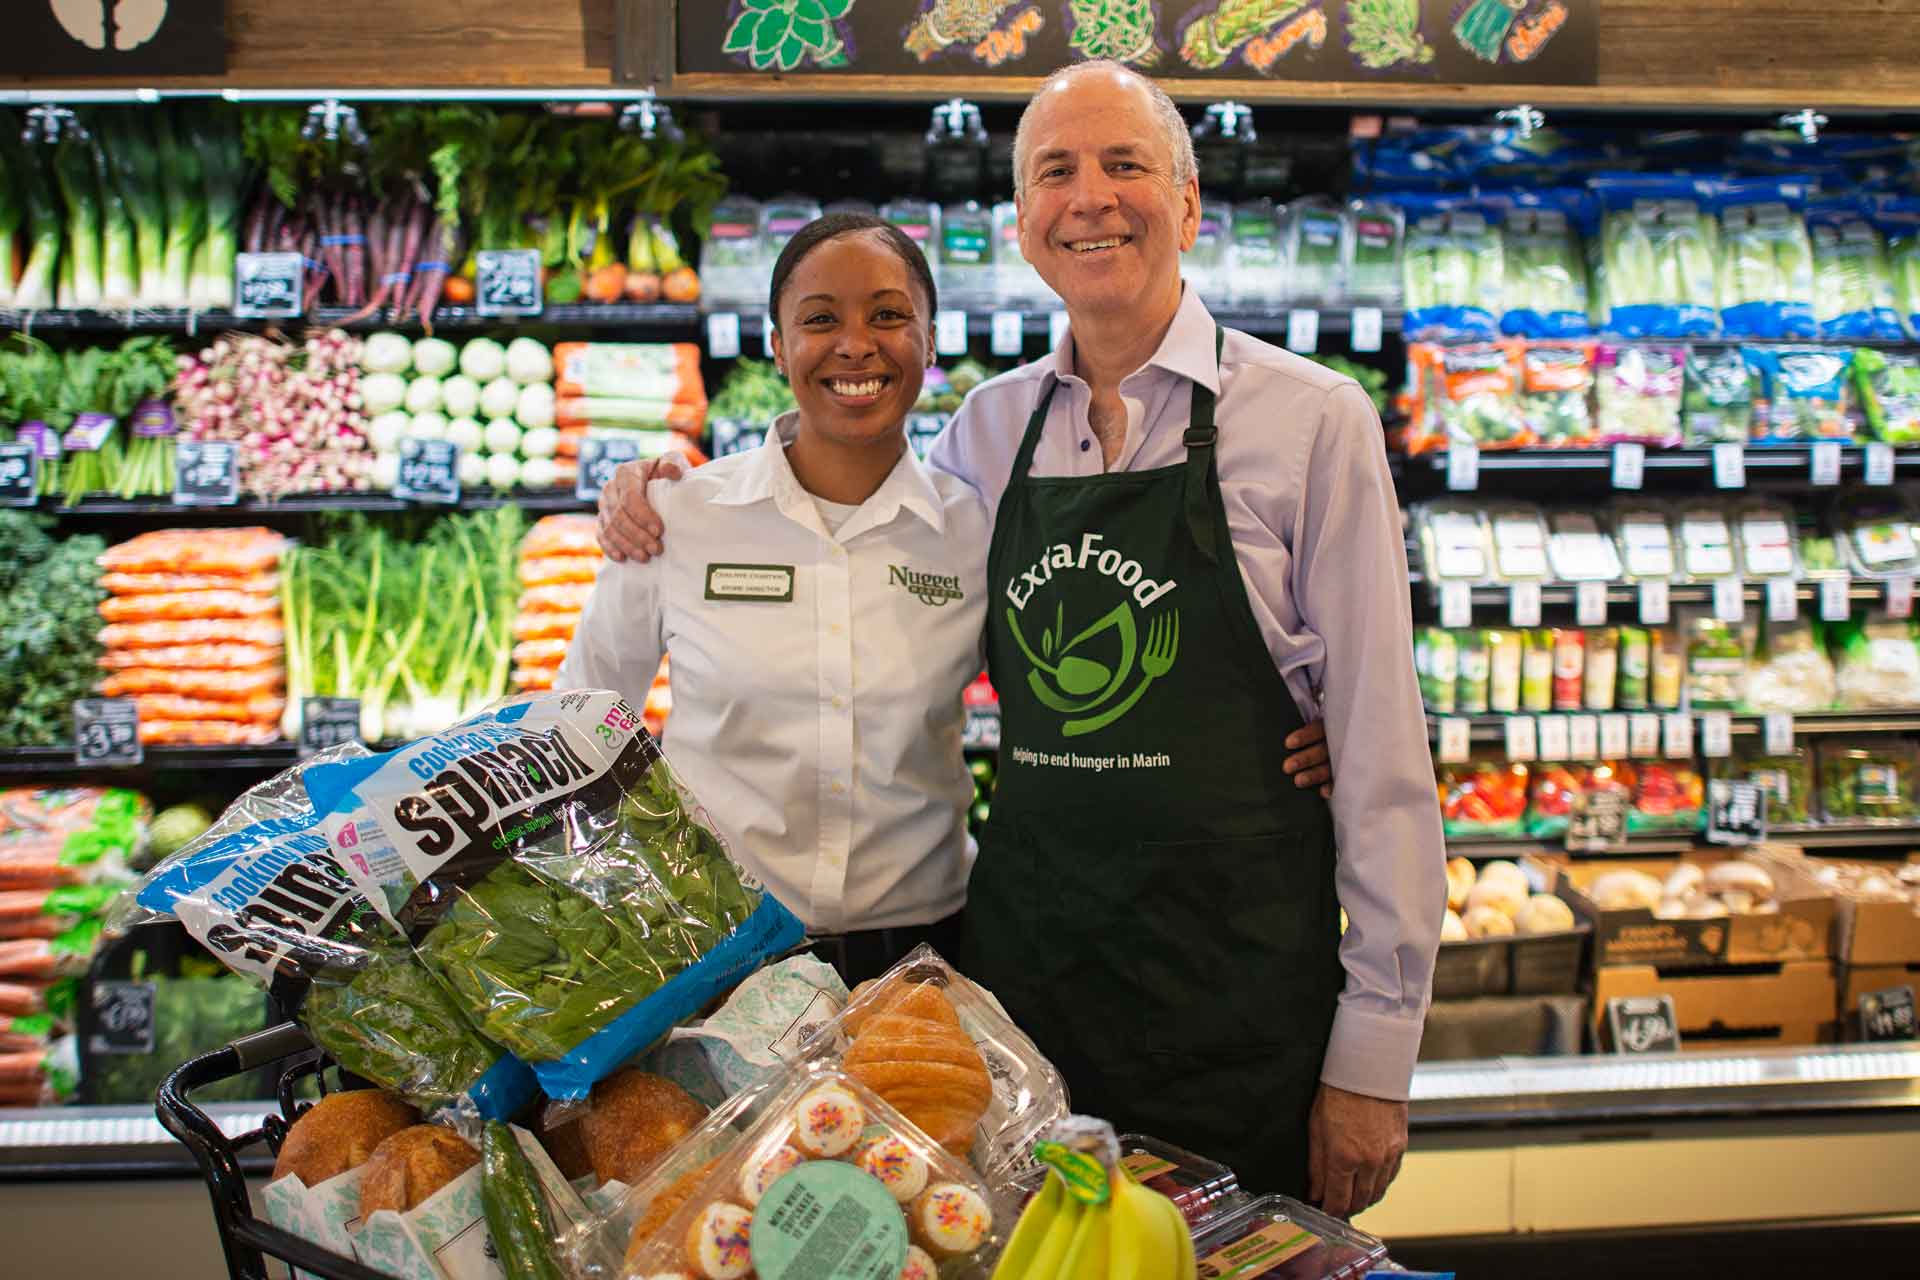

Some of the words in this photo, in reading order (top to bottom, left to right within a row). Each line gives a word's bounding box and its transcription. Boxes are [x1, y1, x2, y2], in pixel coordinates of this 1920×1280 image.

[888, 564, 960, 590] Nugget
[1039, 751, 1049, 766] to
[1051, 752, 1070, 767] end
[1072, 753, 1115, 772] hunger
[1117, 754, 1130, 768] in
[1133, 752, 1171, 769] Marin
[211, 845, 303, 911] cooking
